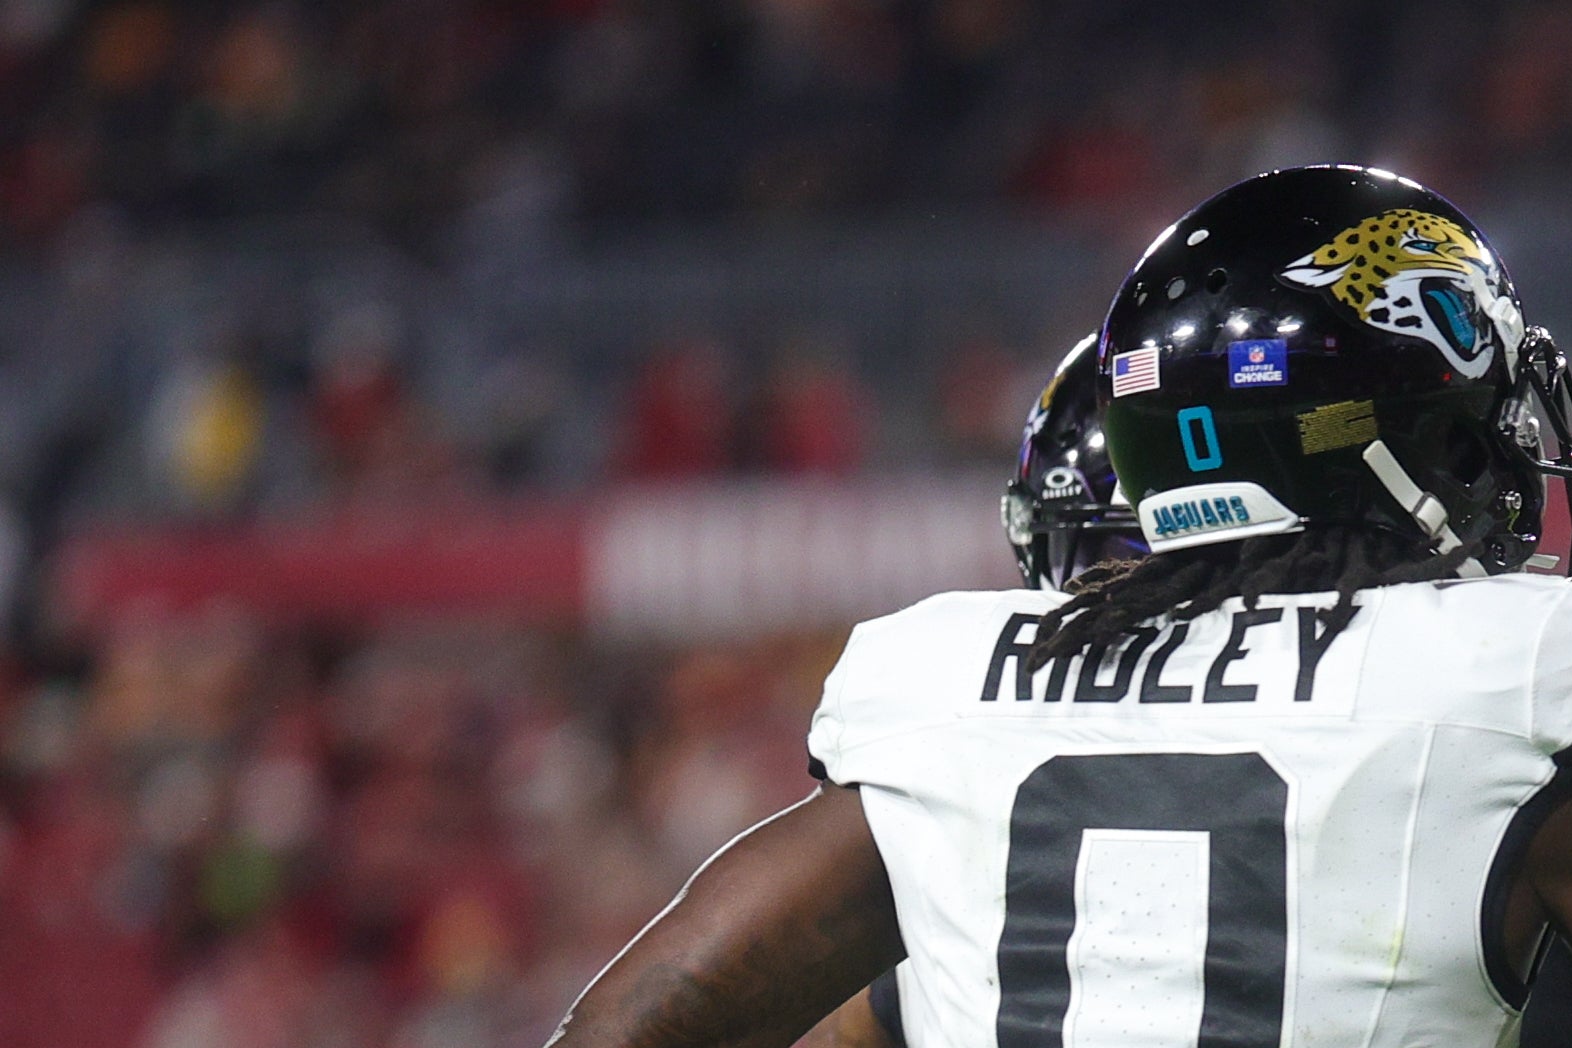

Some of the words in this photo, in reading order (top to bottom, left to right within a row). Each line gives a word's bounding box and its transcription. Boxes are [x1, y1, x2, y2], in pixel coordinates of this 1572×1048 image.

[1234, 370, 1283, 384] CHANGE
[1177, 405, 1223, 472] 0
[1153, 495, 1250, 536] JAGUARS
[980, 604, 1362, 703] RIDLEY
